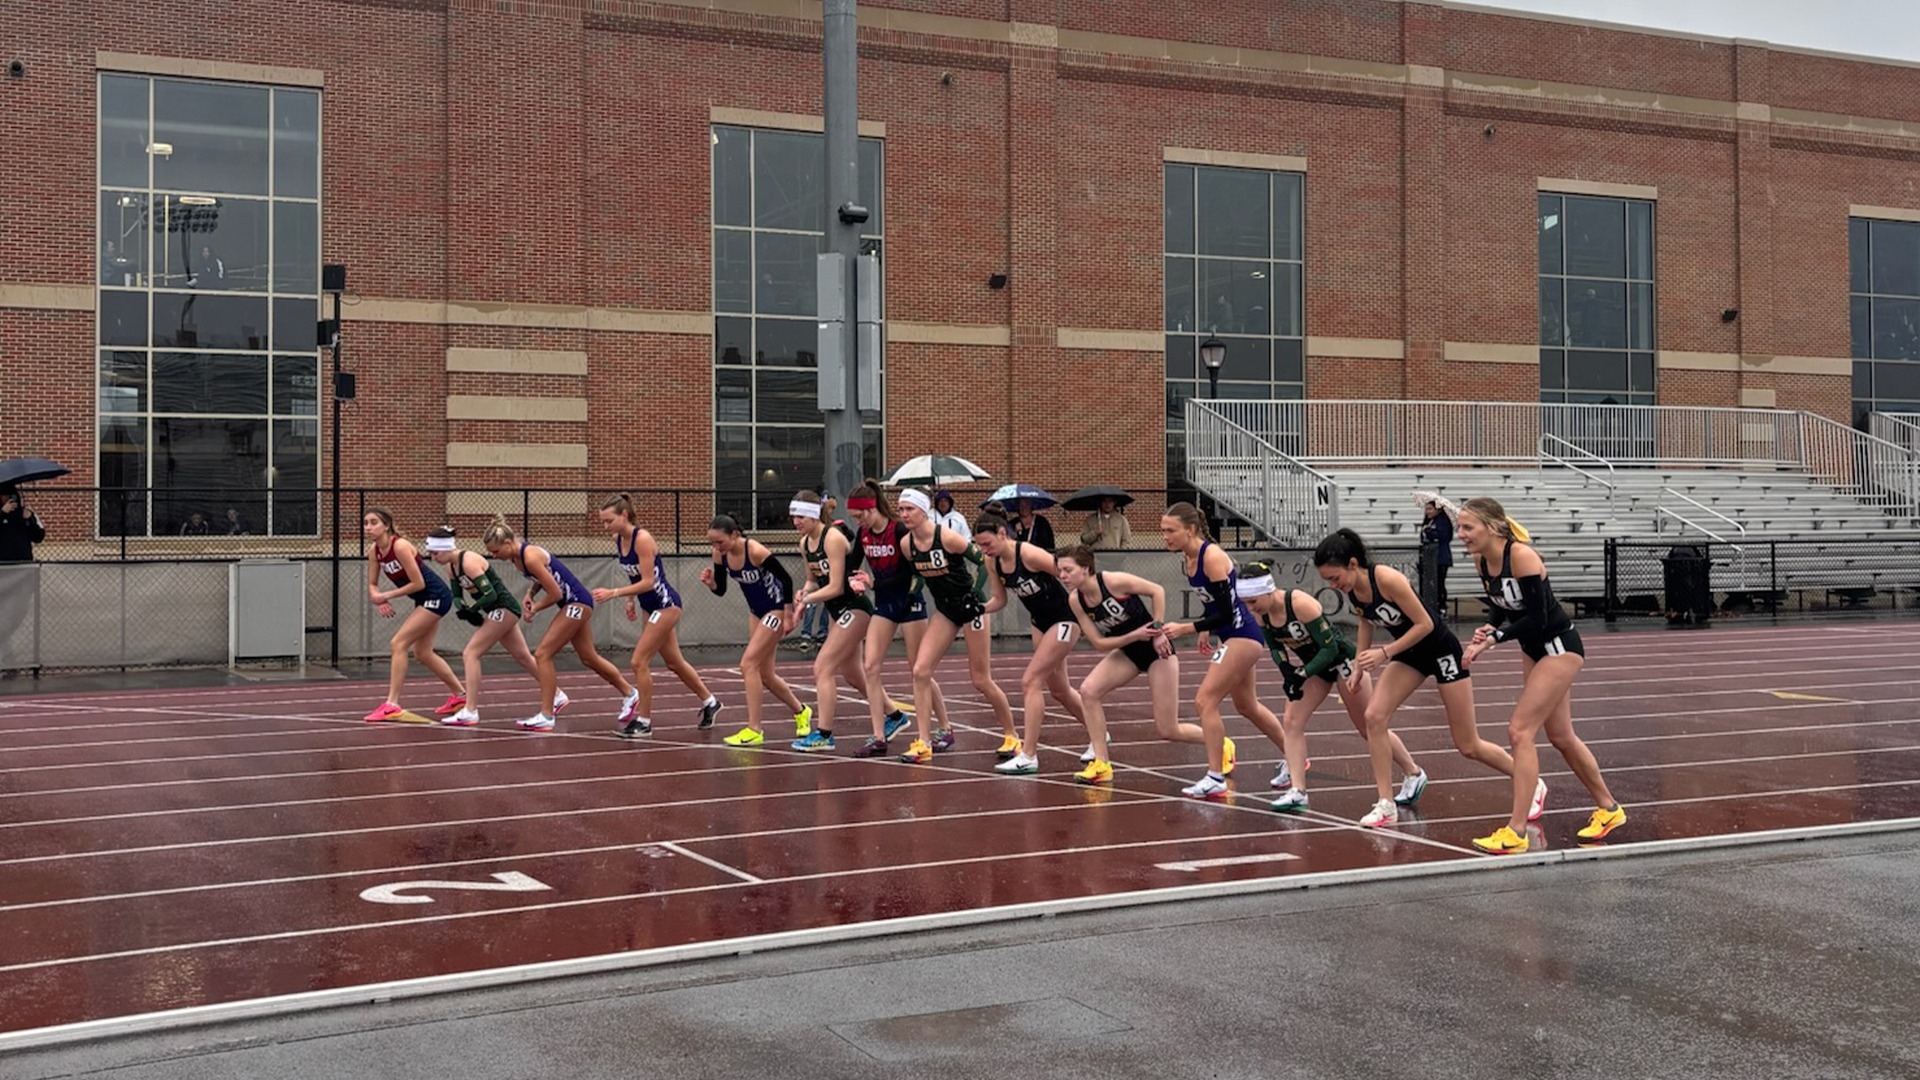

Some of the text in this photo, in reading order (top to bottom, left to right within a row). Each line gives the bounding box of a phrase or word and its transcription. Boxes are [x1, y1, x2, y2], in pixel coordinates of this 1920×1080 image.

[1317, 485, 1329, 505] N
[932, 550, 942, 567] 8
[1293, 558, 1312, 584] of
[568, 606, 582, 618] 12
[1106, 599, 1121, 614] 6
[1378, 606, 1398, 622] 2
[765, 614, 780, 628] 10
[839, 612, 852, 625] 9
[1291, 622, 1305, 639] 3
[1440, 658, 1455, 675] 2
[359, 871, 553, 904] 2
